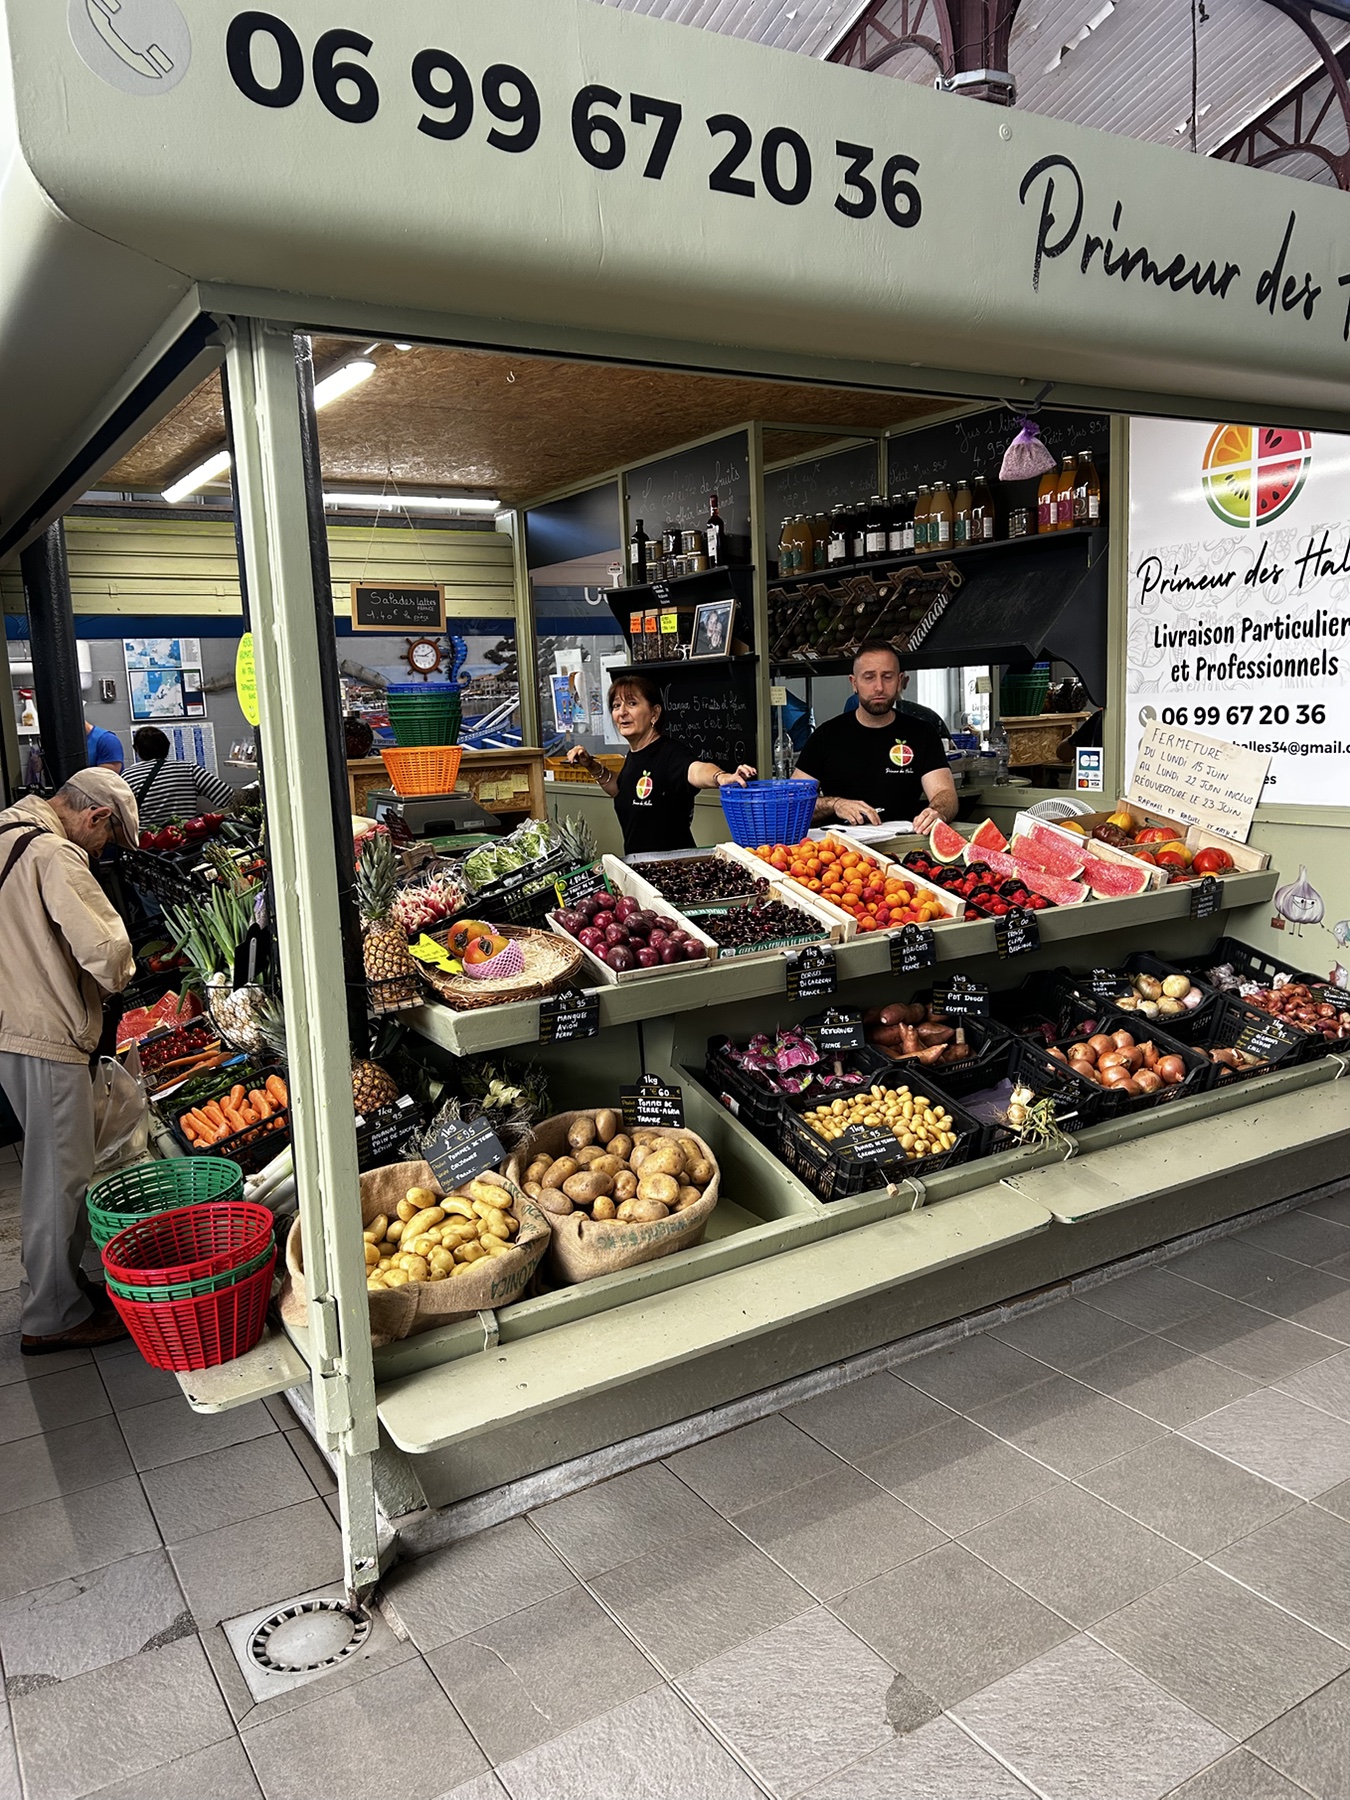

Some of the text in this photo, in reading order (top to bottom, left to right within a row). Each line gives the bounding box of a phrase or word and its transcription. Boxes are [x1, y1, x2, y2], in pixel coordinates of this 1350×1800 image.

[226, 11, 922, 228] 06 99 67 20 36
[1019, 154, 1240, 294] Primeur
[1256, 210, 1322, 320] des
[955, 423, 980, 453] Jus
[700, 475, 711, 493] de
[713, 461, 740, 495] fruits
[1137, 556, 1236, 605] Primeur
[1244, 540, 1284, 587] des
[370, 592, 415, 605] Salades
[1154, 609, 1350, 648] Livraison Particulier
[1171, 648, 1339, 682] et Professionnels
[693, 695, 700, 711] 5
[1162, 704, 1326, 725] 06 99 67 20 36
[1144, 746, 1155, 758] DU
[1192, 761, 1203, 772] 15
[1140, 761, 1150, 771] AU
[1185, 775, 1197, 786] 22
[1190, 794, 1200, 805] LE
[1202, 799, 1215, 809] 23
[806, 948, 818, 957] 1kg
[953, 974, 966, 982] 1kg
[839, 1014, 849, 1022] 95
[643, 1074, 658, 1085] 1kg
[640, 1088, 646, 1096] 1
[658, 1088, 670, 1096] 60
[375, 1111, 402, 1129] 5 95
[371, 1125, 397, 1141] ANANAS
[441, 1124, 457, 1138] 1kg
[463, 1127, 476, 1139] 95
[850, 1124, 865, 1133] 1kg
[869, 1130, 880, 1138] 95
[372, 1136, 389, 1148] PAIN
[390, 1132, 398, 1140] DE
